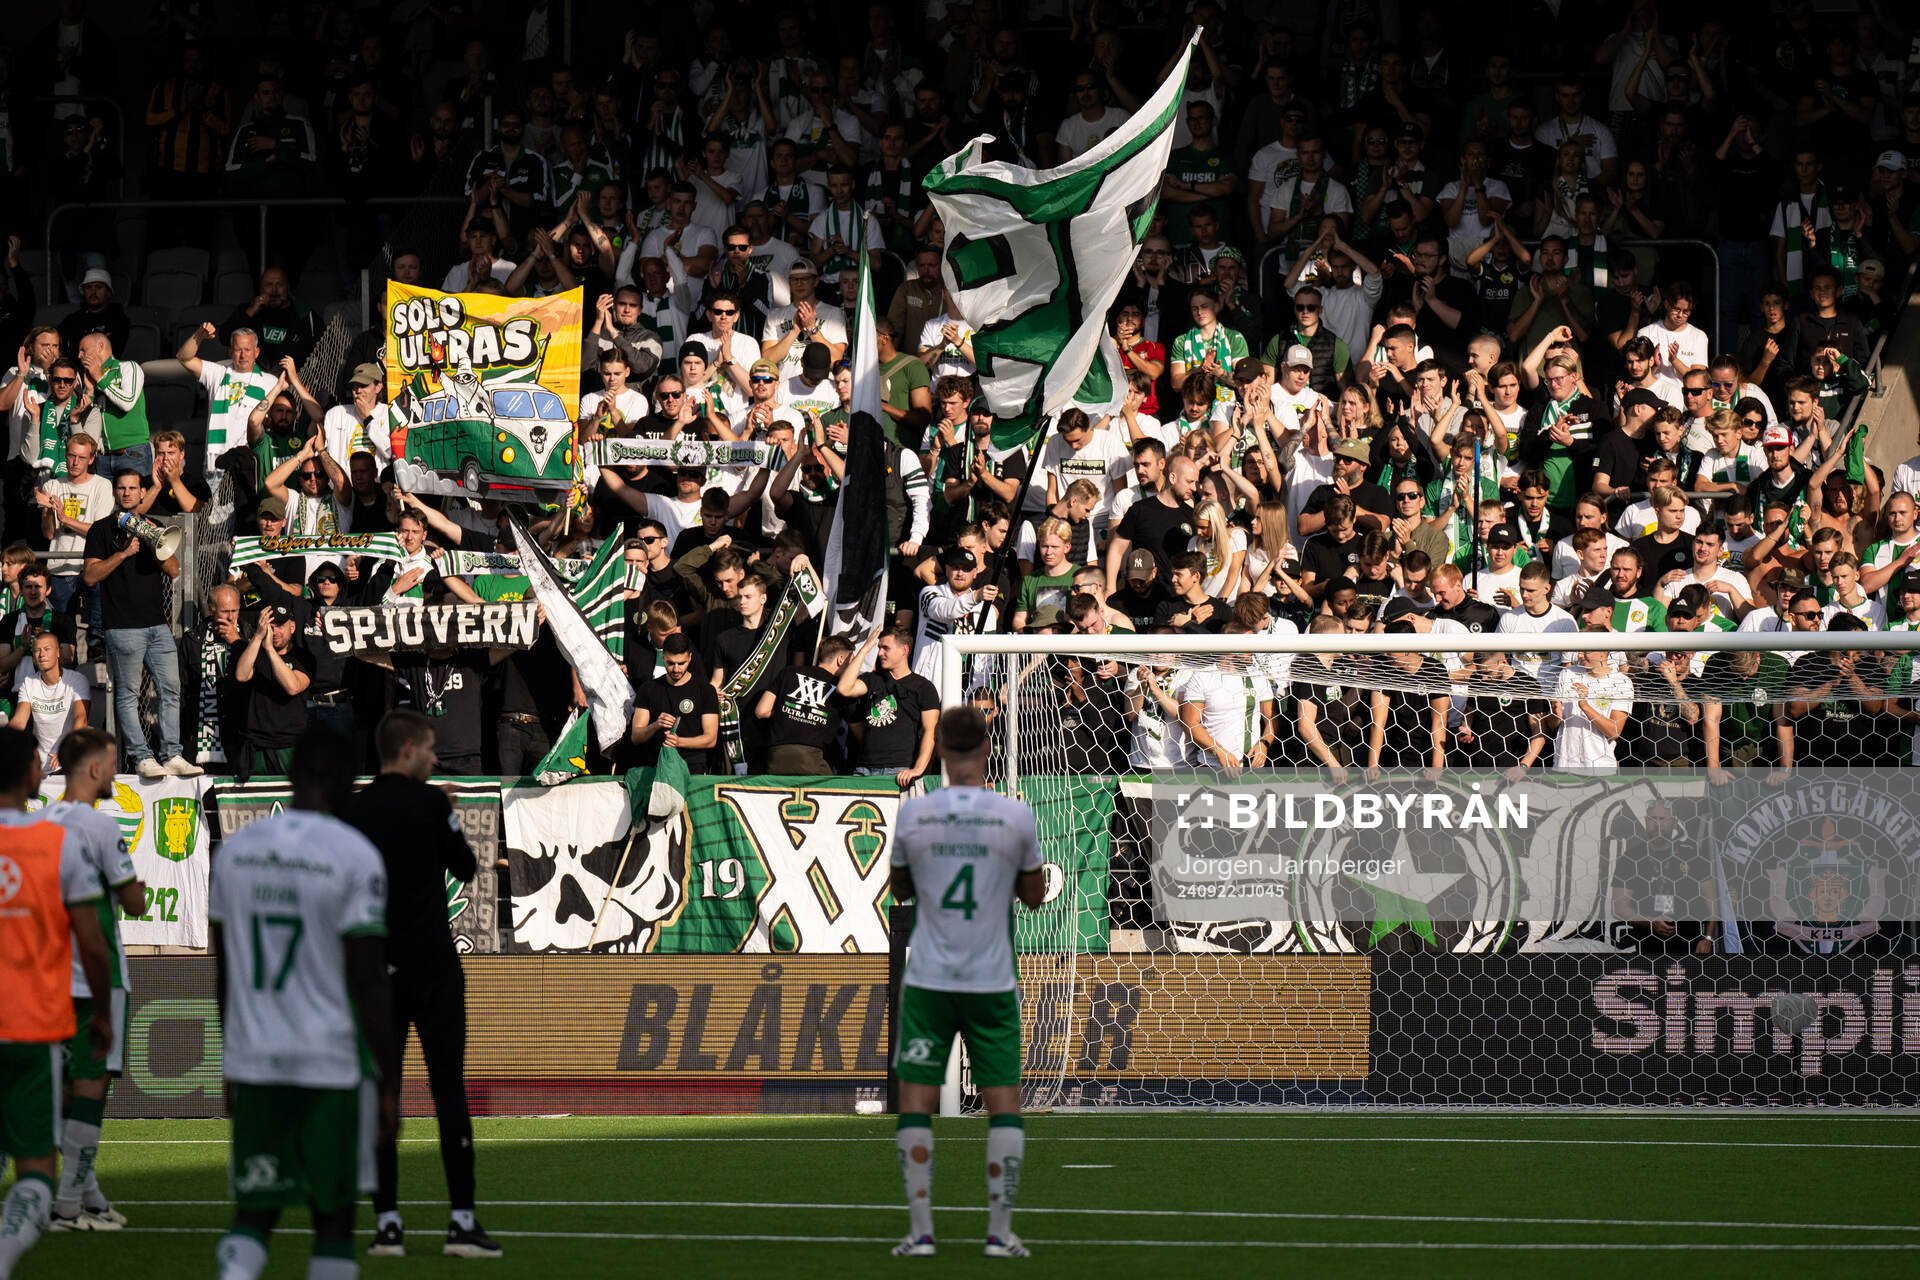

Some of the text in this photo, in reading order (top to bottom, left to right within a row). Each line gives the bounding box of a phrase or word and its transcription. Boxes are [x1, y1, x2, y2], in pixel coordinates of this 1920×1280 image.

[393, 297, 464, 334] SOLO
[399, 320, 536, 368] ULTRAS
[325, 604, 537, 653] SPJUVERN
[782, 705, 828, 726] ULTRA BOYS
[697, 858, 751, 900] 19
[943, 864, 978, 921] 4
[252, 914, 304, 990] 17
